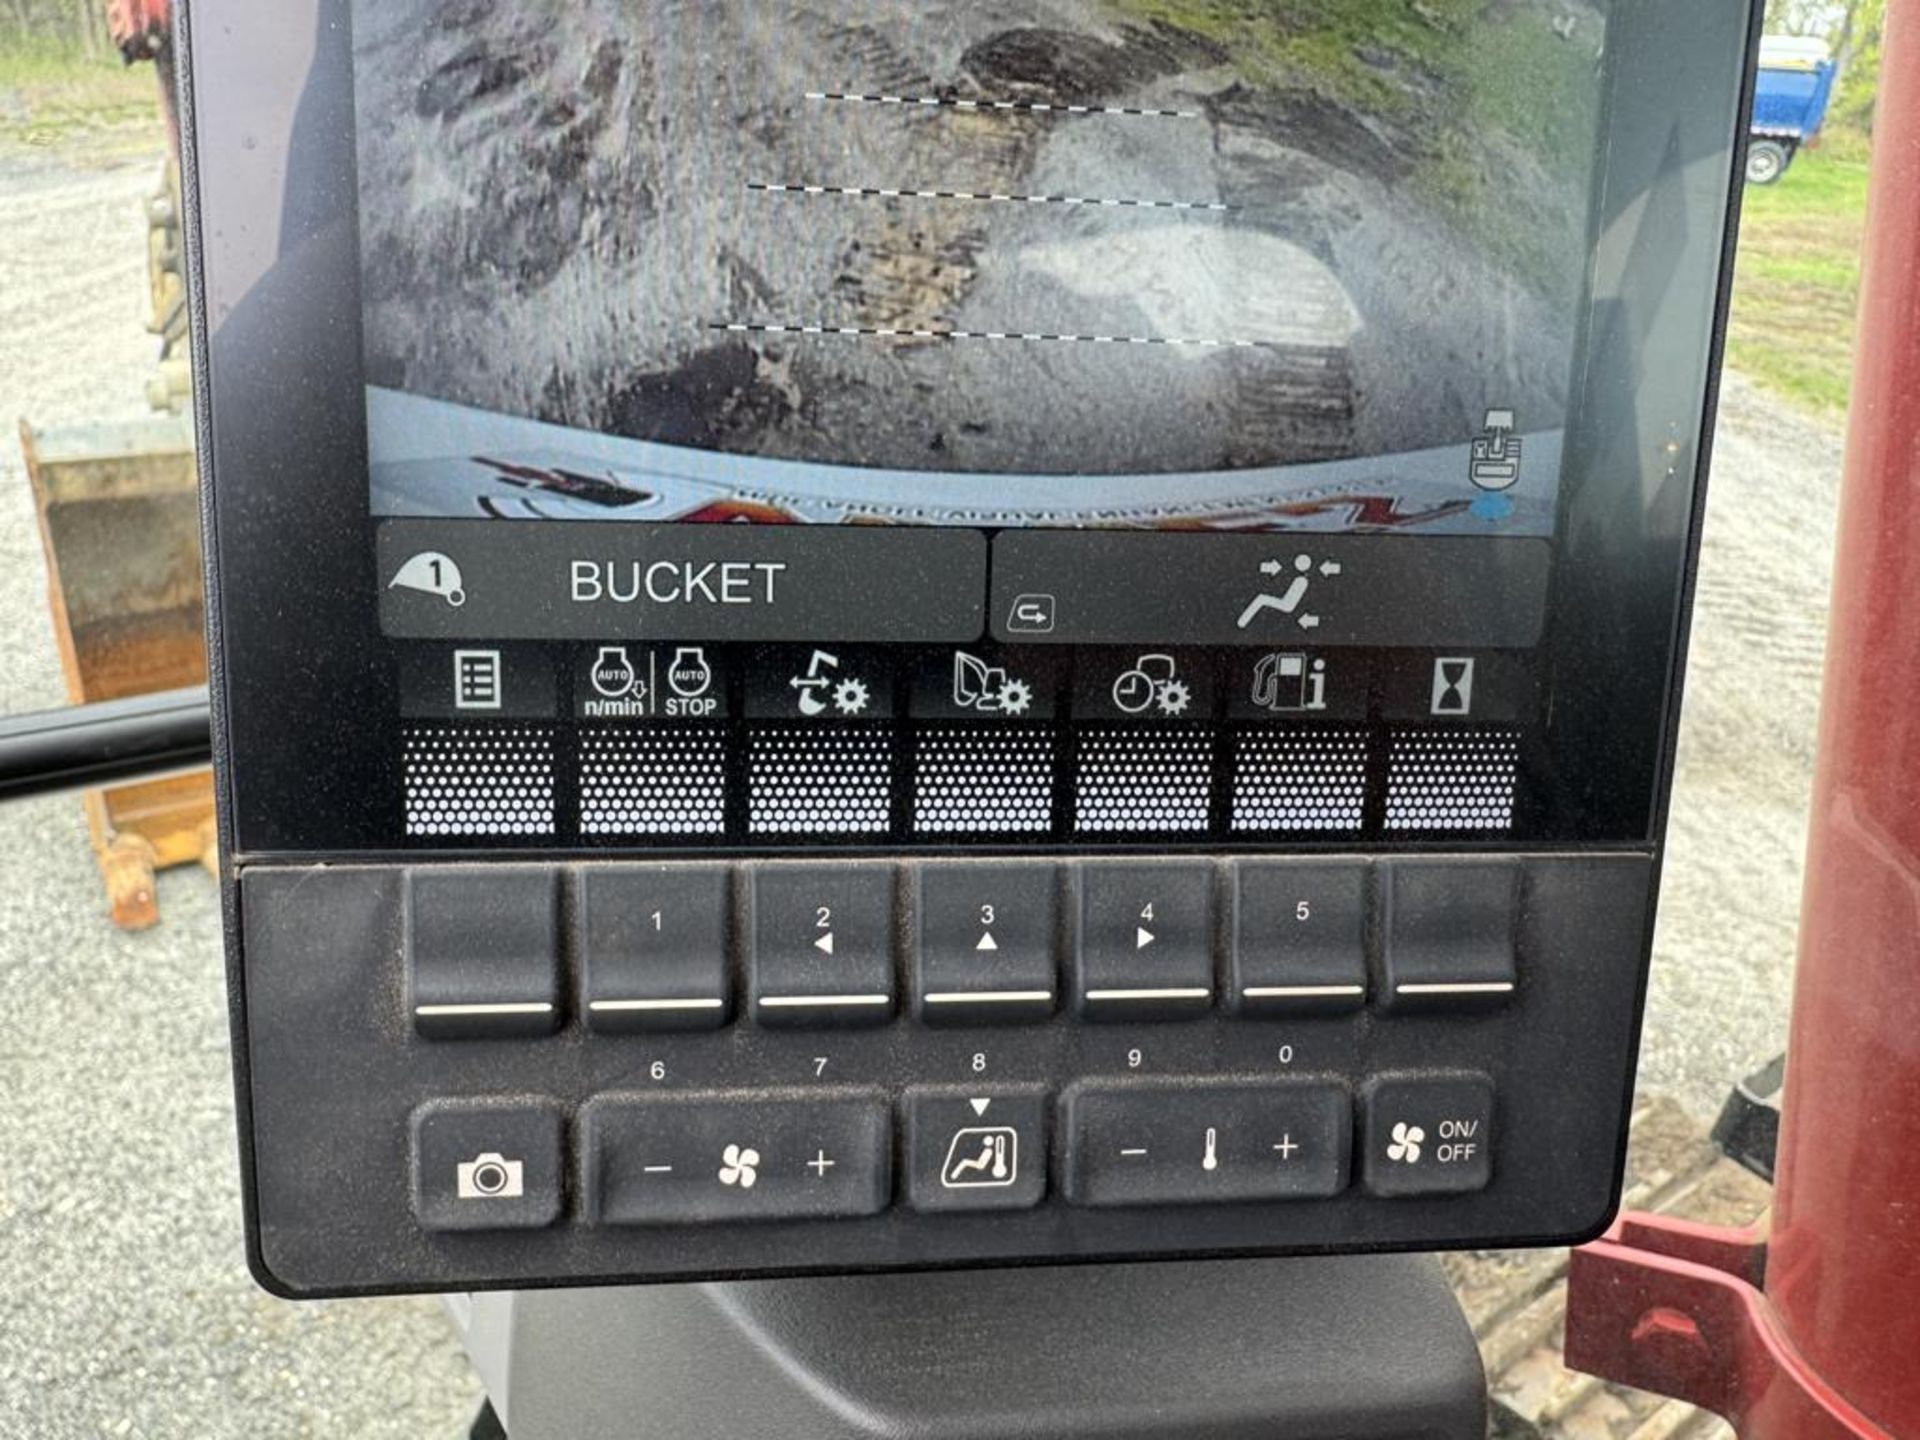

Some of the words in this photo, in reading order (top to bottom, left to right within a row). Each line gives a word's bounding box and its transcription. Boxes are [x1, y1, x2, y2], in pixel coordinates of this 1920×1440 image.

[429, 559, 442, 588] 1
[571, 560, 786, 604] BUCKET
[598, 669, 629, 681] AUTO
[674, 669, 706, 681] AUTO
[584, 697, 644, 717] n/min
[665, 697, 717, 716] STOP
[651, 911, 661, 931] 1
[816, 906, 831, 927] 2
[980, 904, 995, 924] 3
[1140, 902, 1154, 921] 4
[1296, 901, 1310, 921] 5
[814, 1057, 828, 1077] 7
[972, 1052, 986, 1072] 8
[1127, 1048, 1142, 1068] 9
[650, 1060, 665, 1081] 6
[1439, 1120, 1478, 1140] ON/
[1437, 1143, 1476, 1163] OFF
